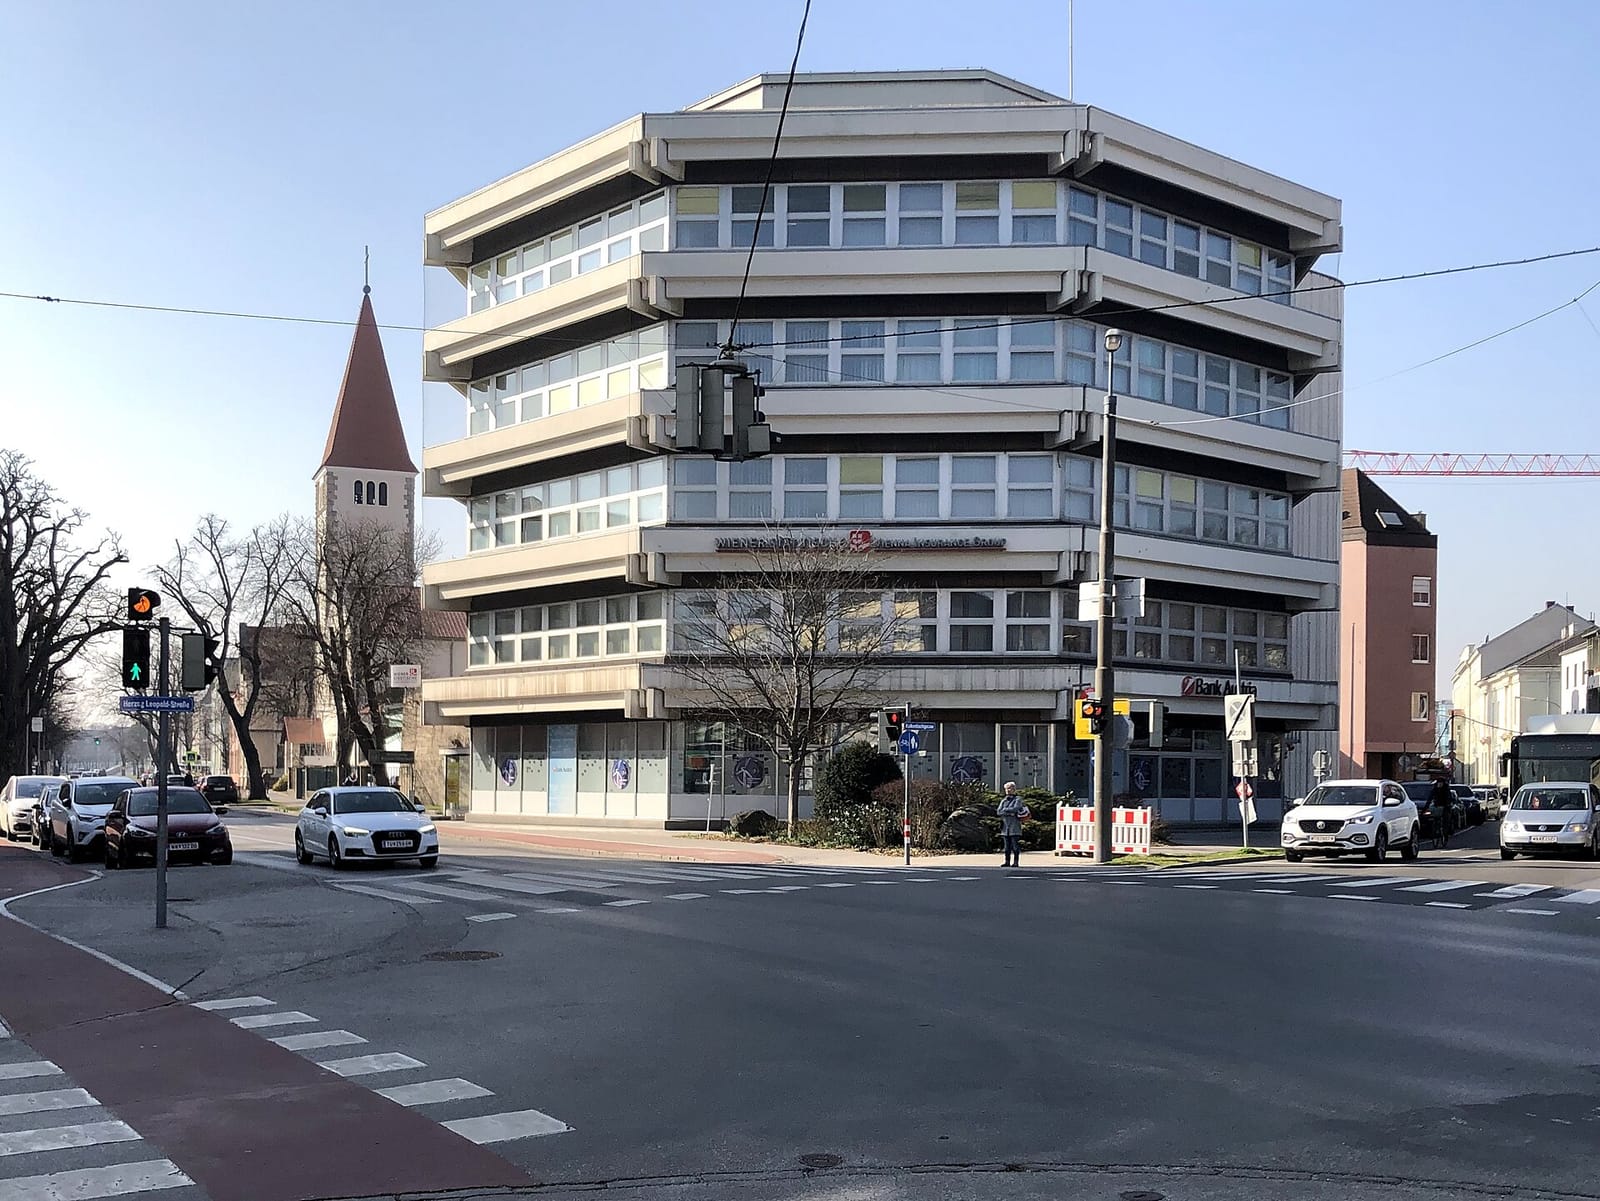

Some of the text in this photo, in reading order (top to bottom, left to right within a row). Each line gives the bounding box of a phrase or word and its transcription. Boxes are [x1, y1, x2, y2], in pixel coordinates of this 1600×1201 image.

[716, 538, 768, 549] WIENER
[914, 537, 970, 548] INSURANCE
[974, 536, 1007, 547] GROUP
[1195, 677, 1223, 696] Bank
